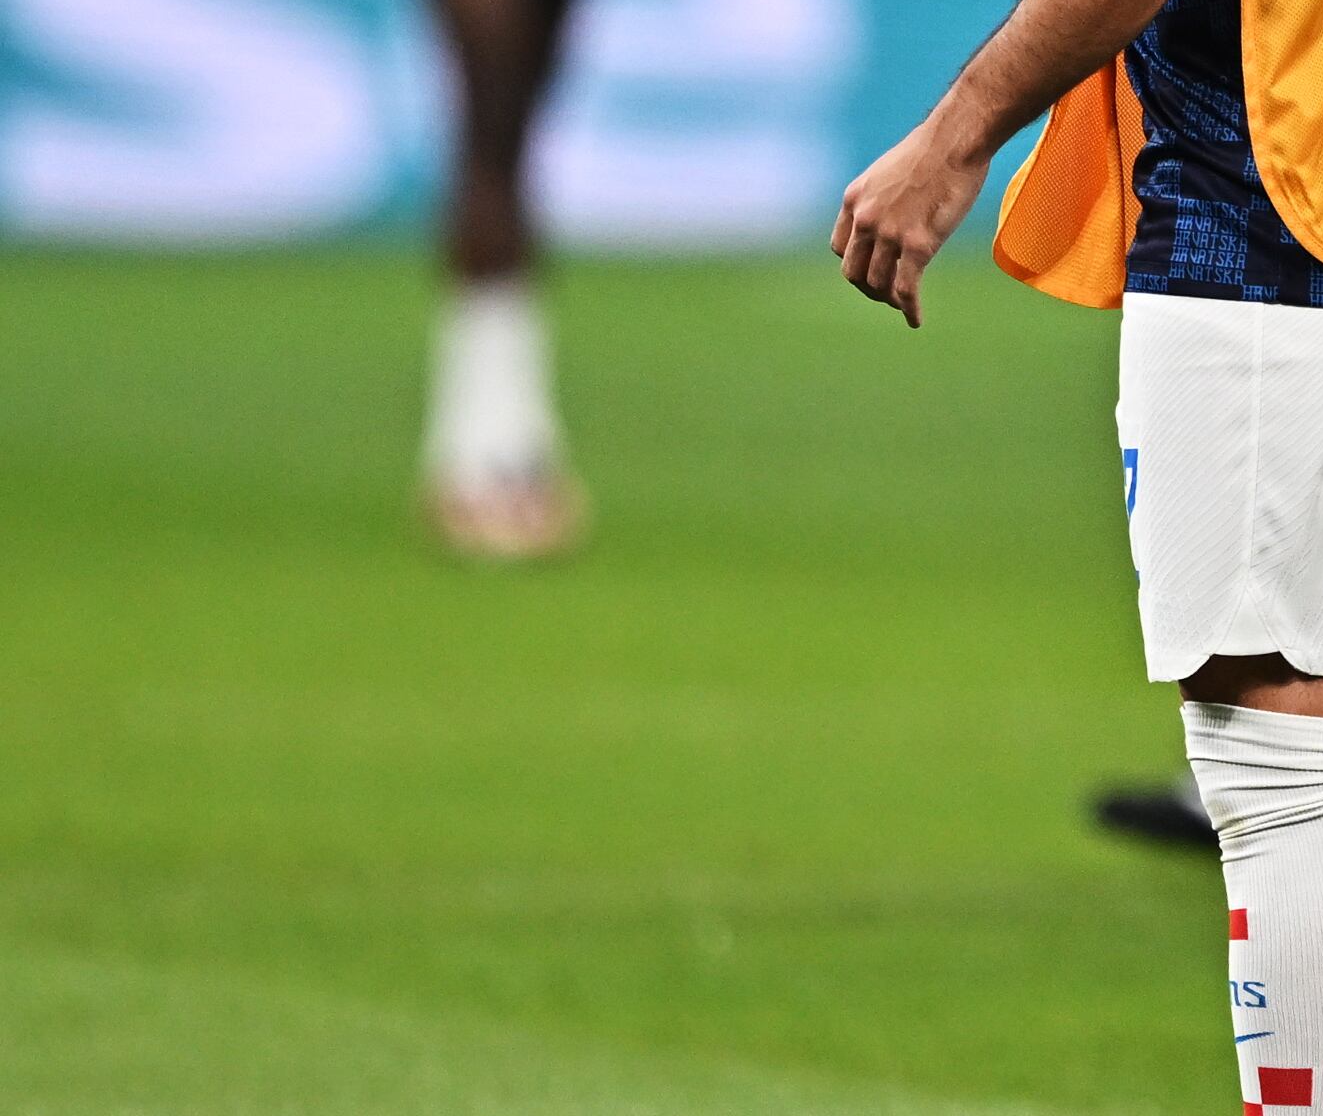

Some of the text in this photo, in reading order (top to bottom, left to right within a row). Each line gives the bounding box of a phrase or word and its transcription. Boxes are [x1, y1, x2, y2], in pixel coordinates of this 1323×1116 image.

[1177, 197, 1249, 220] HRVATSKA
[1172, 231, 1246, 252] HRVATSKA
[1170, 248, 1245, 269] HRVATSKA
[1168, 265, 1244, 285] HRVATSKA
